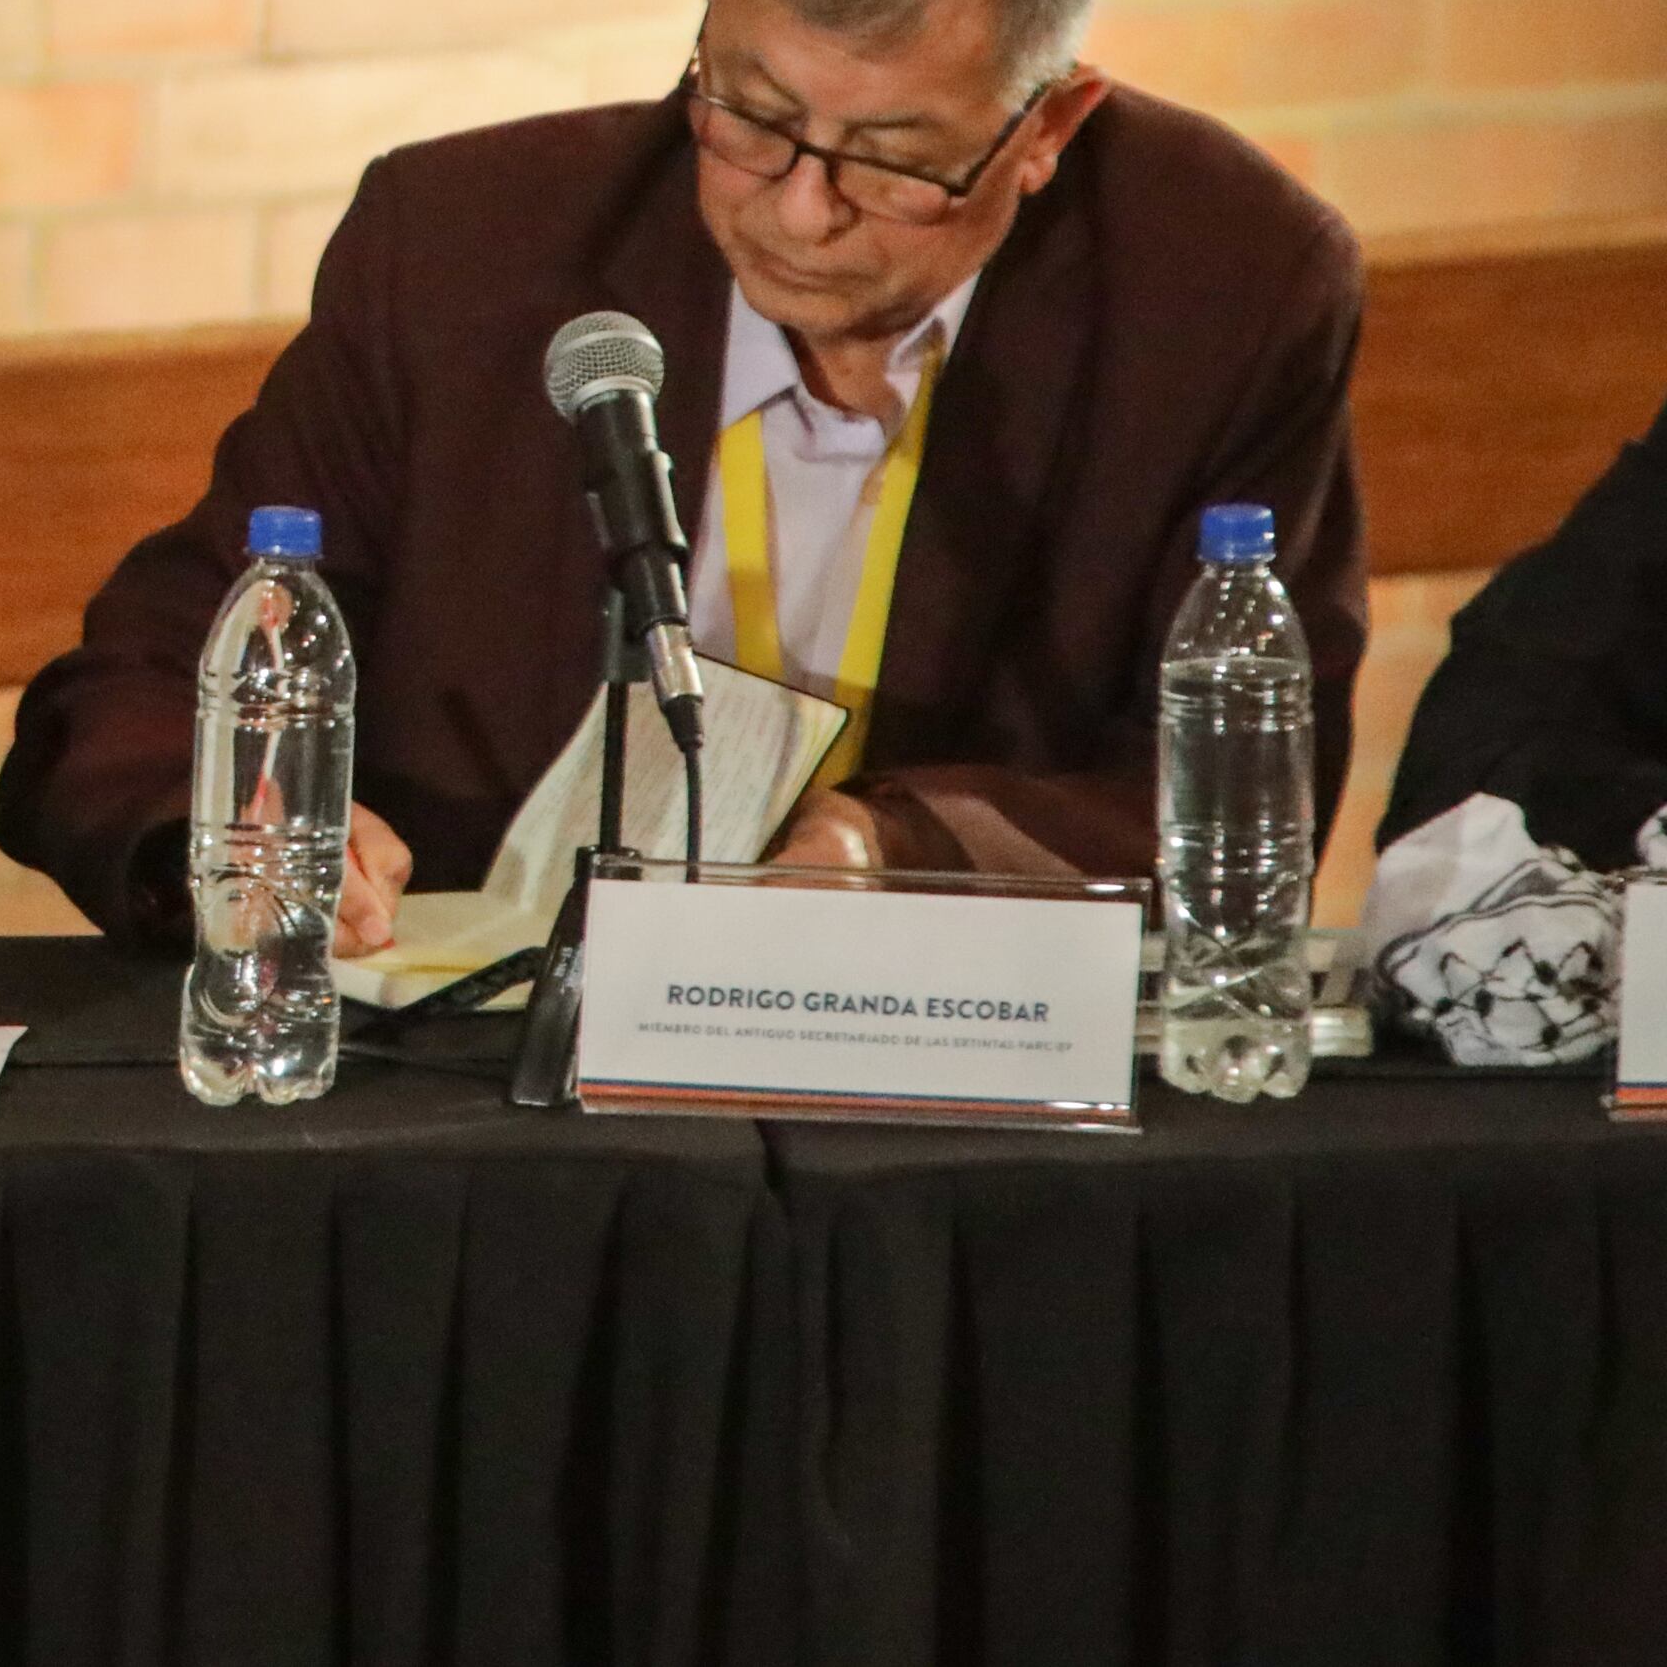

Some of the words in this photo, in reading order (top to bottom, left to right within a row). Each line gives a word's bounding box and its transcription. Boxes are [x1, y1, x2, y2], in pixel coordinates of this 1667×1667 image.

[666, 984, 796, 1011] RODRIGO
[802, 991, 918, 1017] GRANDA
[925, 997, 1049, 1023] ESCOBAR
